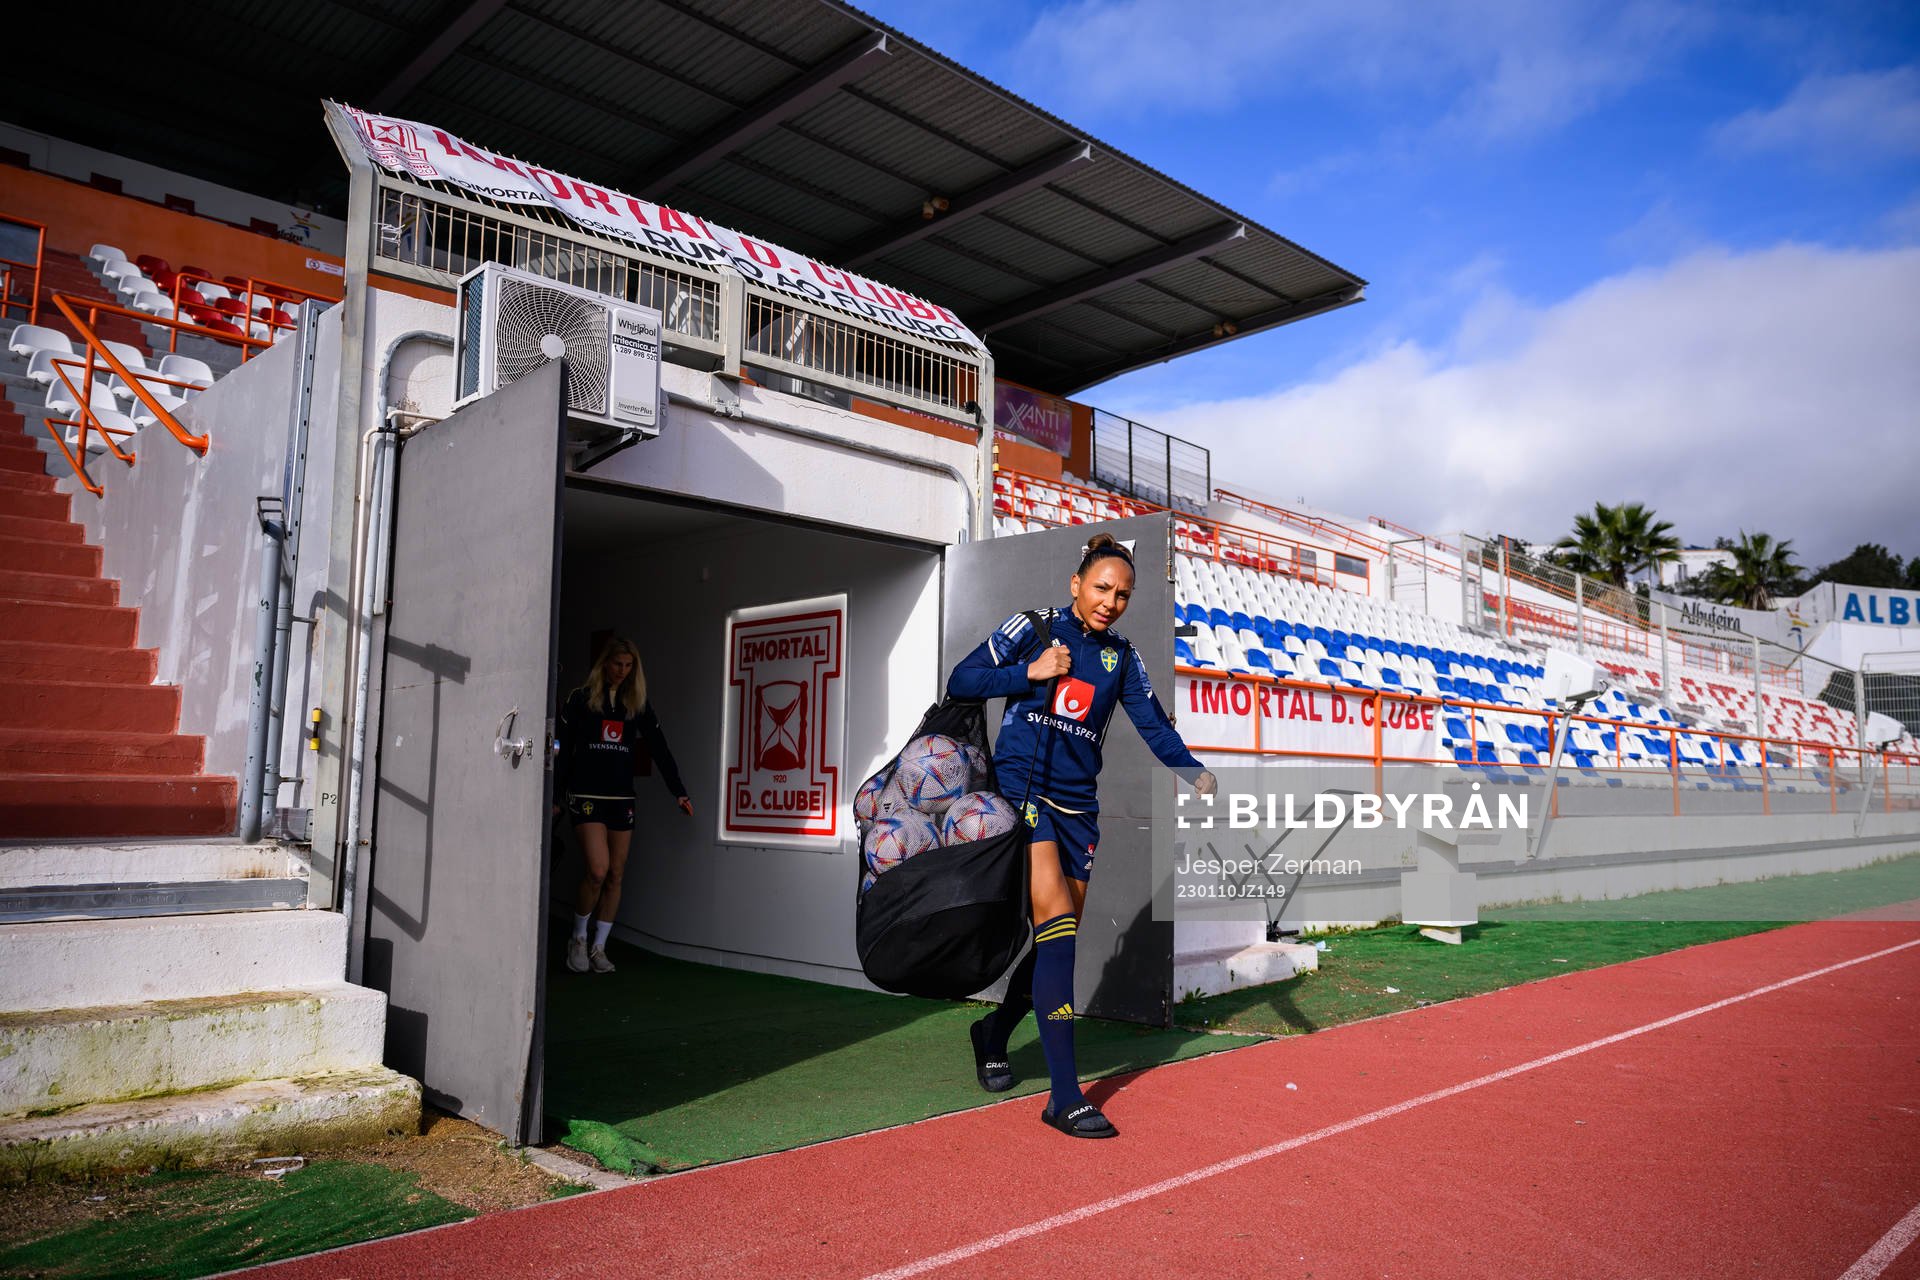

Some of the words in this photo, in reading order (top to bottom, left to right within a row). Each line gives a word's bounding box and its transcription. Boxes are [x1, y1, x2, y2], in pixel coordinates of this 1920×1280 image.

[641, 227, 763, 278] RUMO
[777, 273, 826, 300] AO
[831, 290, 963, 340] FUTURO
[618, 318, 657, 337] Whirlpool
[620, 346, 632, 355] 289
[633, 349, 645, 359] 898
[1006, 401, 1059, 432] XANTI
[1680, 602, 1741, 634] Albufeira
[743, 635, 826, 663] IMORTAL
[1190, 679, 1322, 722] IMORTAL
[1331, 694, 1354, 725] D.
[1027, 712, 1073, 734] SVENSKA
[1074, 726, 1098, 742] SPEL
[773, 774, 787, 784] 1920
[321, 792, 338, 807] P2
[740, 790, 757, 810] D.
[761, 790, 821, 811] CLUBE
[1047, 1013, 1073, 1021] adida
[1067, 1105, 1093, 1119] CRAFT
